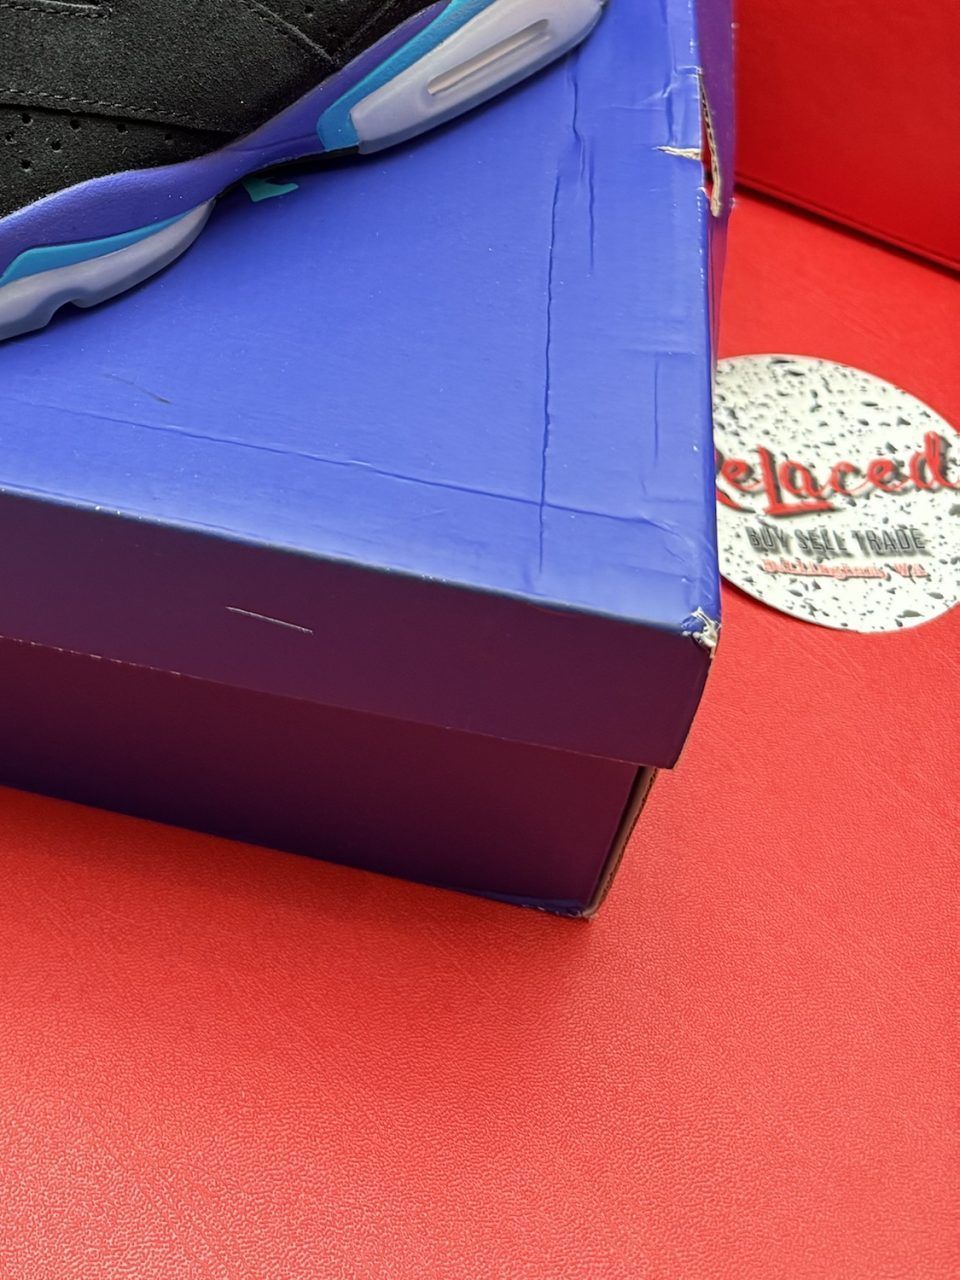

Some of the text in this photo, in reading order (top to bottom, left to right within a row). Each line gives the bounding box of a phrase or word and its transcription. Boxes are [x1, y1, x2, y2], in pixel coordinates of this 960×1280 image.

[744, 525, 927, 555] BUY SELL TRADE
